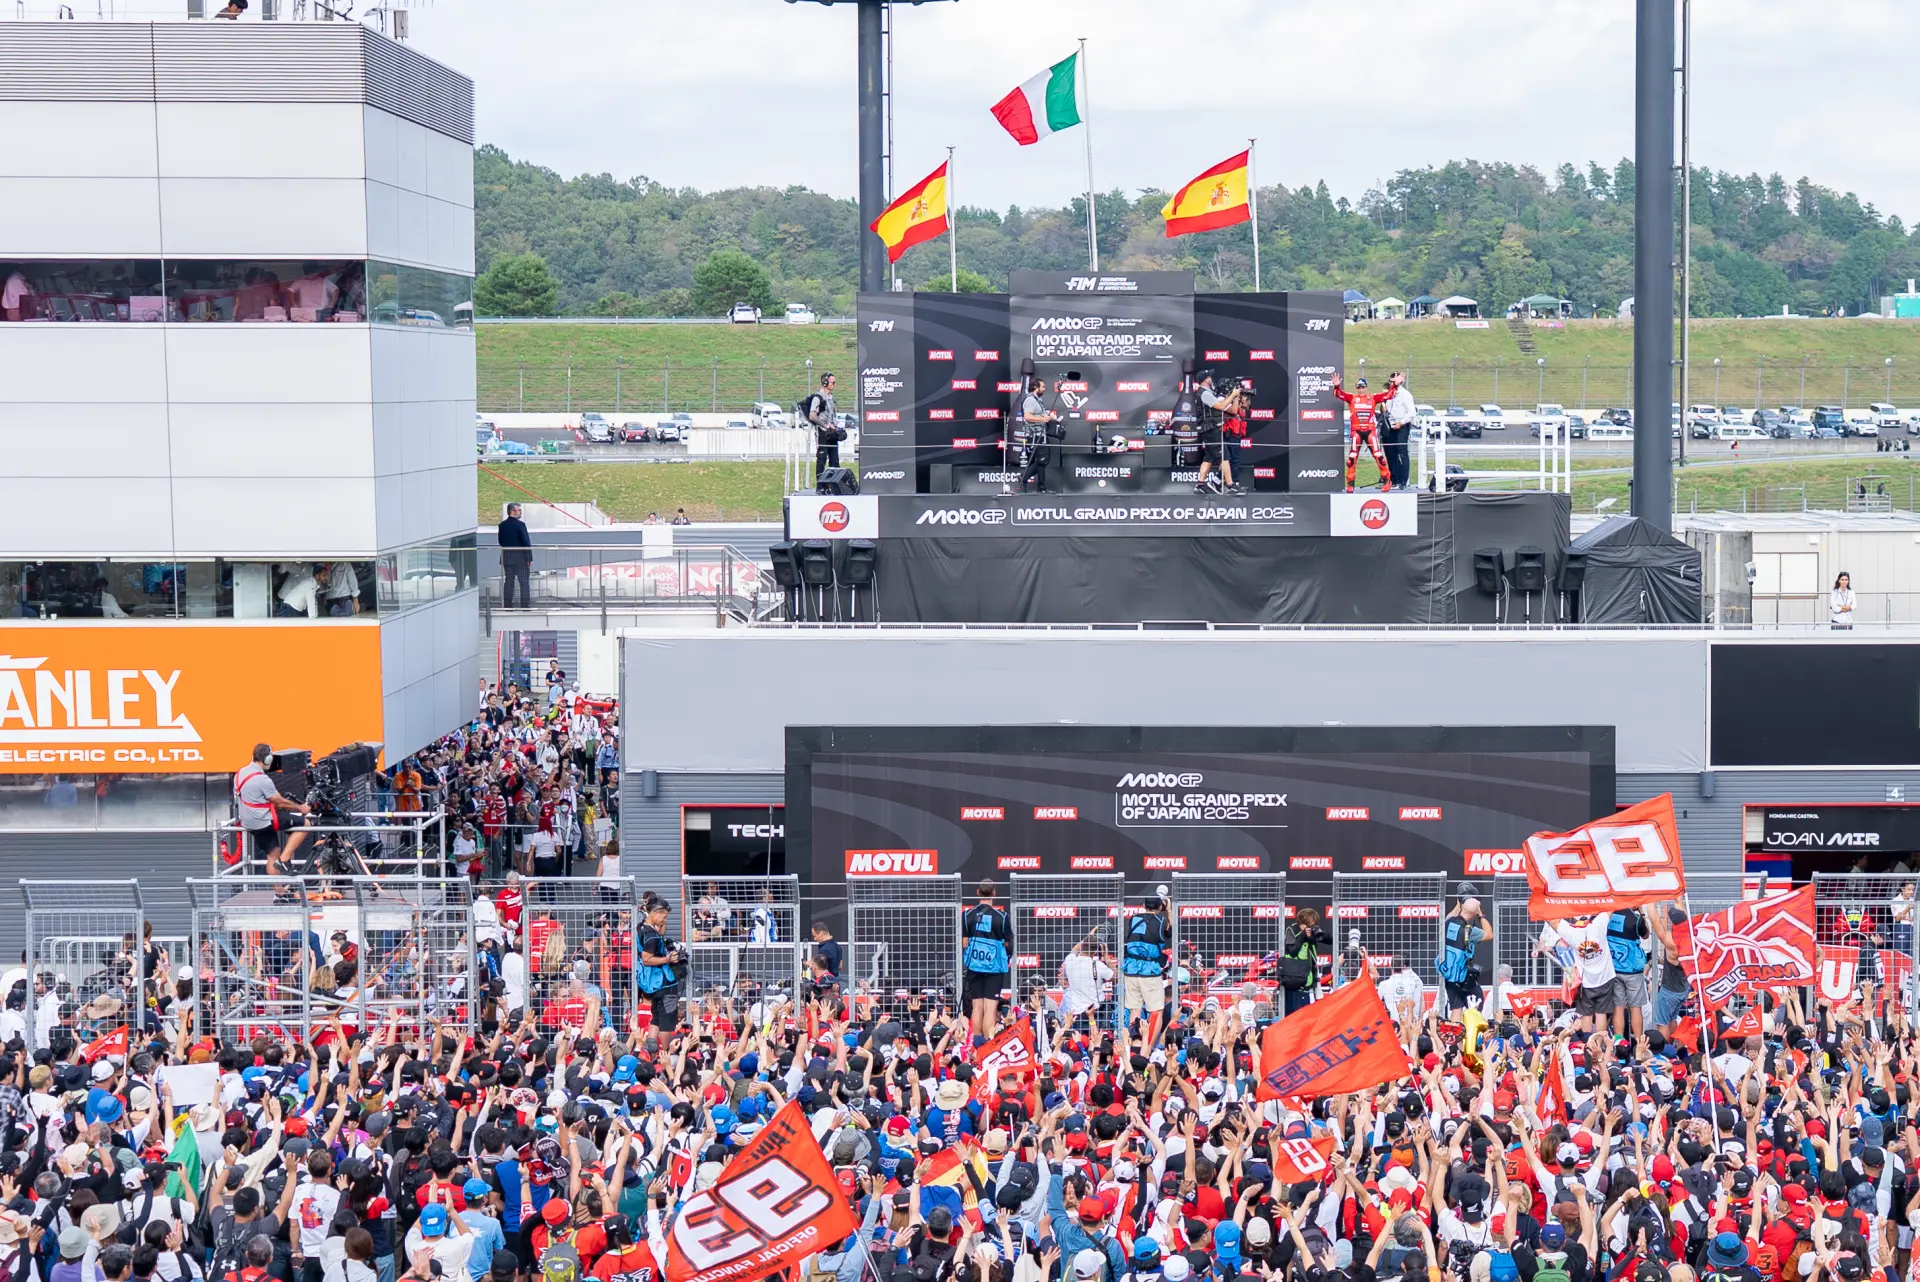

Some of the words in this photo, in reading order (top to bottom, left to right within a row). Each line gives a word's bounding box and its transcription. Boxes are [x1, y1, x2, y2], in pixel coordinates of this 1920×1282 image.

[1065, 277, 1097, 291] FIM
[868, 320, 895, 332] FIM
[1031, 316, 1103, 330] MotoGP
[1304, 319, 1331, 330] FIM
[1036, 334, 1085, 346] MOTUL
[1086, 334, 1134, 346] GRAND
[1136, 334, 1173, 346] PRIX
[929, 351, 954, 360] MOTUL
[975, 351, 999, 360] MOTUL
[1036, 345, 1055, 357] OF
[1056, 345, 1101, 357] JAPAN
[1103, 345, 1142, 357] 2025
[1206, 351, 1229, 360] MOTUL
[1250, 351, 1274, 360] MOTUL
[862, 367, 900, 376] MotoGP
[1296, 366, 1336, 374] MotoGP
[952, 380, 976, 389] MOTUL
[997, 383, 1021, 391] MOTU
[1117, 382, 1149, 391] MOTUL
[867, 412, 899, 420] MOTUL
[930, 410, 954, 418] MOTUL
[975, 409, 999, 418] MOTUL
[1087, 411, 1118, 420] MOTUL
[1251, 410, 1274, 418] MOTUL
[1302, 410, 1334, 420] MOTUL
[953, 439, 976, 448] MOTUL
[863, 470, 906, 480] MotoGP
[1076, 467, 1118, 478] PROSECCO
[1297, 469, 1340, 478] MotoGP
[915, 509, 1007, 525] MotoGP
[1017, 508, 1072, 520] MOTUL
[1074, 508, 1128, 520] GRAND
[1130, 508, 1171, 520] PRIX
[1173, 508, 1195, 520] OF
[1196, 508, 1247, 520] JAPAN
[1252, 507, 1294, 519] 2025
[2, 749, 106, 763] ELECTRIC
[1116, 772, 1204, 788] MotoGP
[1890, 788, 1900, 798] 4
[1122, 794, 1181, 806] MOTUL
[1183, 794, 1241, 806] GRAND
[1243, 794, 1288, 806] PRIX
[962, 808, 1004, 819] MOTUL
[1036, 808, 1076, 819] MOTUL
[1122, 807, 1145, 820] OF
[1147, 807, 1202, 820] JAPAN
[1204, 807, 1250, 820] 2025
[1328, 808, 1368, 819] MOTUL
[1400, 808, 1440, 819] MOTUL
[1766, 832, 1824, 846] JOAN
[1826, 832, 1880, 846] MIR
[848, 853, 935, 873] MOTUL
[999, 857, 1039, 868] MOTUL
[1072, 857, 1112, 868] MOTUL
[1146, 857, 1186, 868] MOTUL
[1218, 857, 1258, 868] MOTUL
[1291, 857, 1331, 868] MOTUL
[1364, 857, 1404, 868] MOTUL
[1468, 852, 1528, 872] MOT
[1035, 907, 1076, 917] MOTUL
[1182, 907, 1222, 917] MOTUL
[1400, 907, 1439, 917] MOTUL
